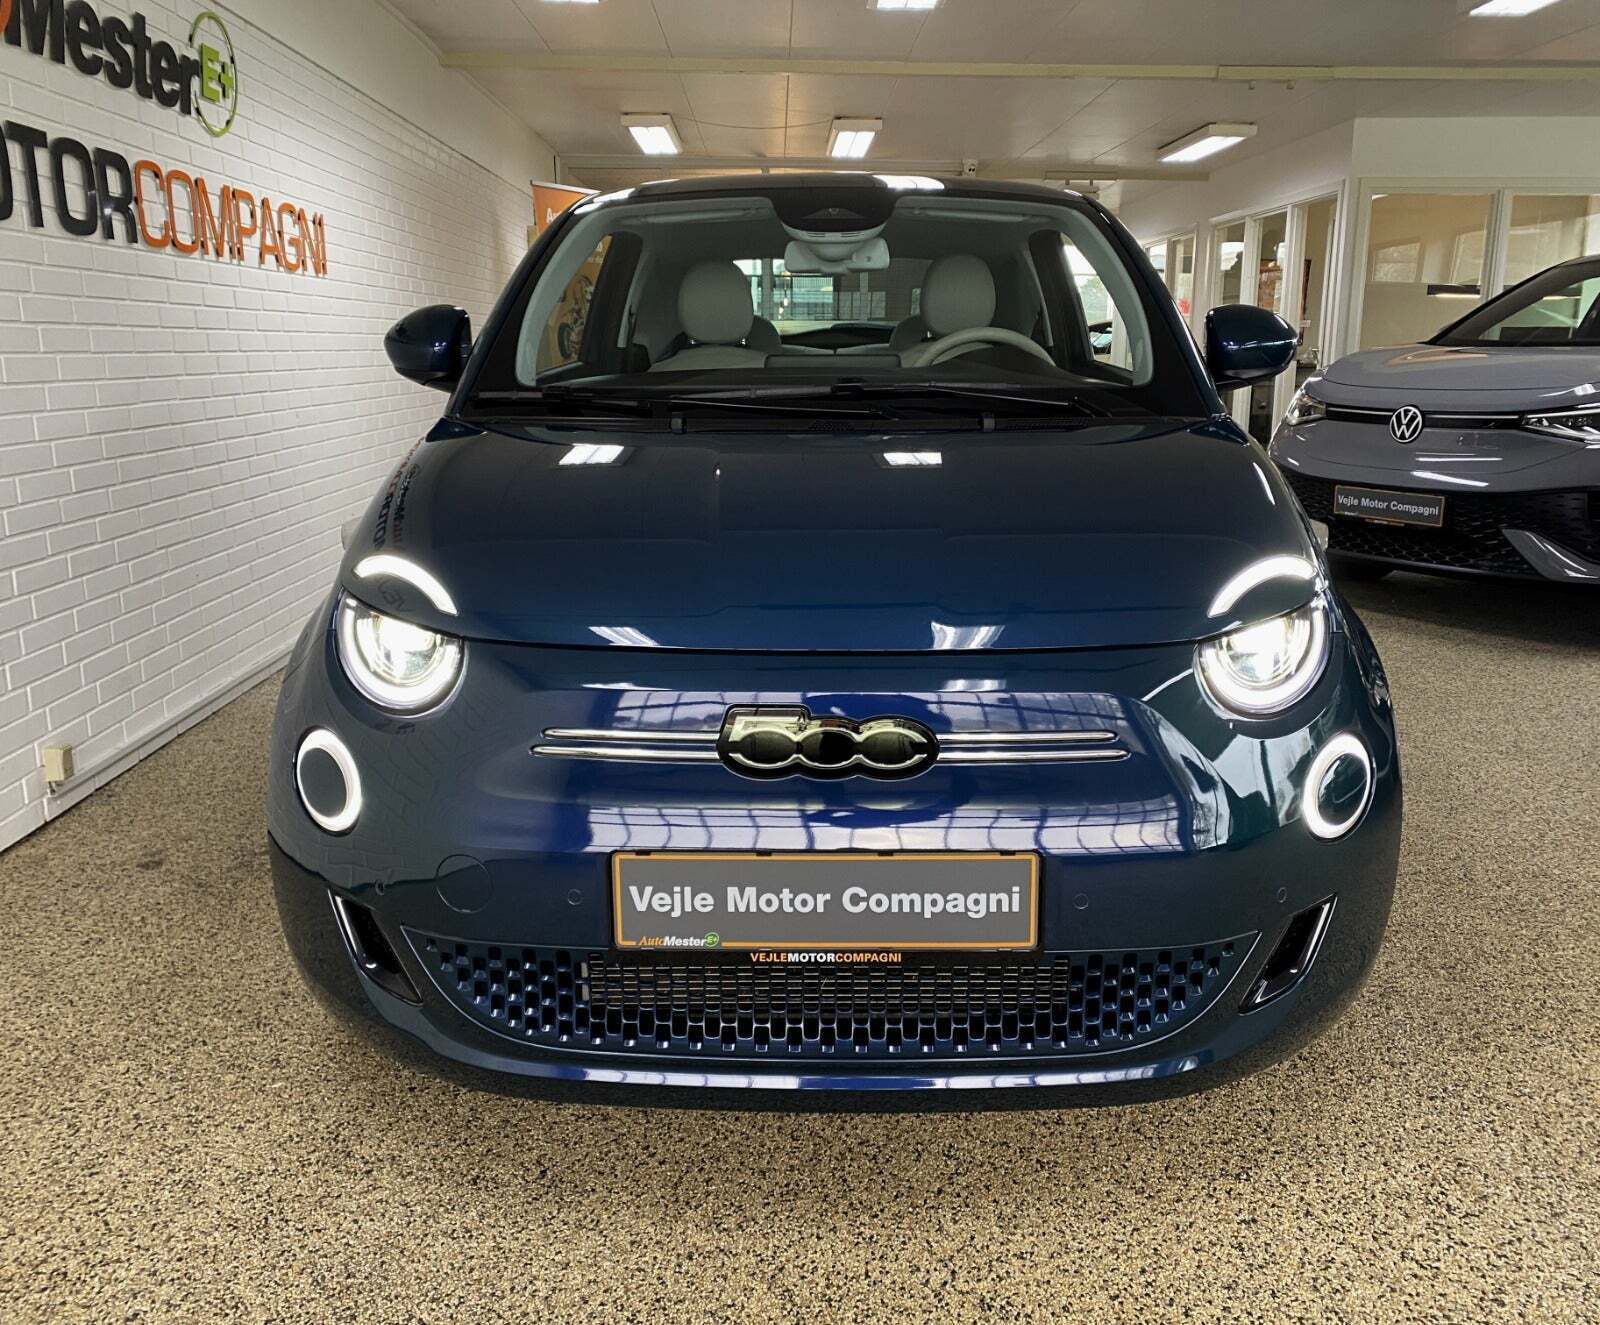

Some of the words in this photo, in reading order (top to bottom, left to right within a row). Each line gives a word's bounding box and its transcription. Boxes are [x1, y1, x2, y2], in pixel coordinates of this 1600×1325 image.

[0, 0, 200, 115] Mester
[0, 119, 328, 277] TORCOMPAGNI
[1338, 495, 1359, 507] Vejle
[1360, 497, 1388, 510] Motor
[1390, 501, 1439, 516] Compagni
[628, 886, 714, 917] Vejle
[727, 886, 831, 913] Motor
[842, 886, 1020, 919] Compagni
[750, 952, 902, 963] VEJLEMOTORCOMPAGNI
